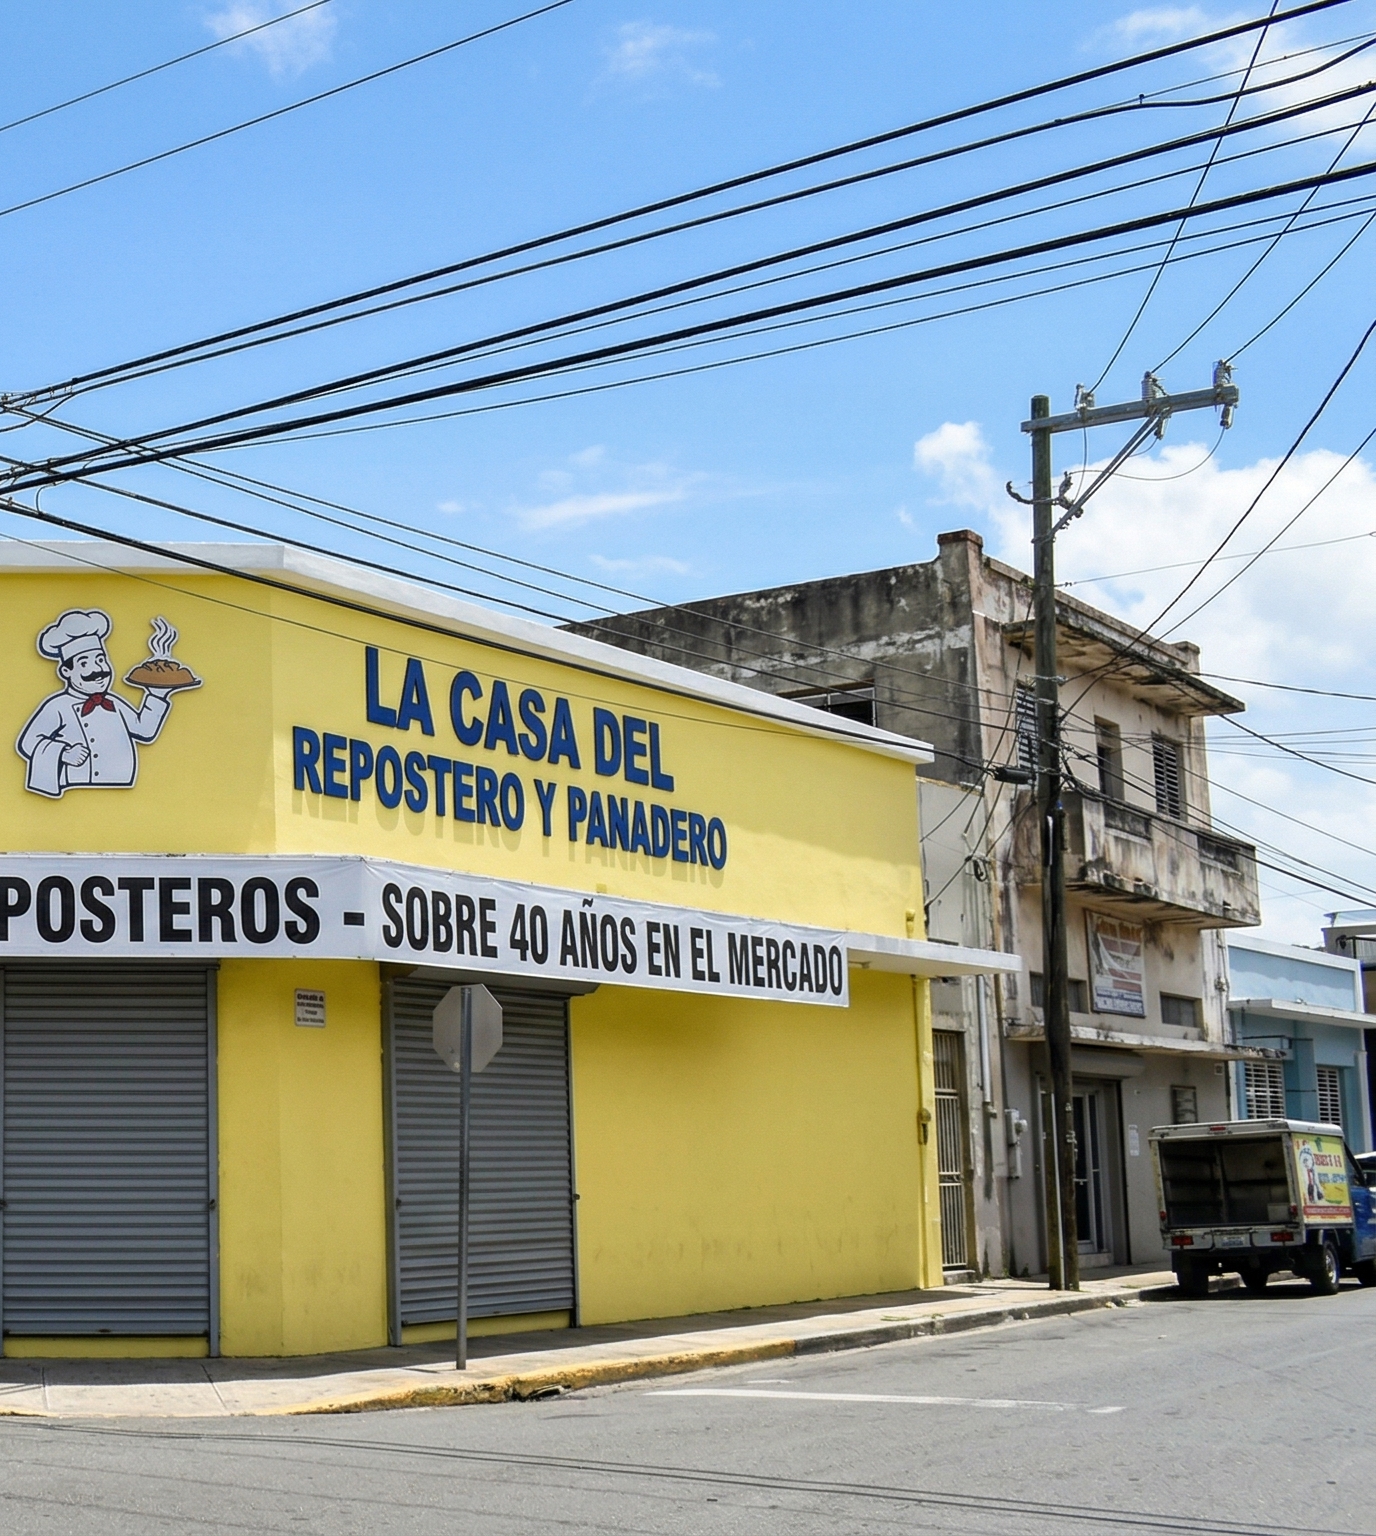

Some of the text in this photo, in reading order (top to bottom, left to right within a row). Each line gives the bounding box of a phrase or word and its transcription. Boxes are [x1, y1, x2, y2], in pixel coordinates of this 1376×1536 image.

[365, 646, 675, 792] LA CASA DEL
[292, 725, 727, 870] REPOSTERO Y PANADERO
[381, 882, 498, 959] SOBRE
[509, 903, 548, 965] 40
[559, 898, 637, 974] AÑOS
[647, 920, 681, 979] EN
[690, 925, 720, 983] EL
[728, 931, 843, 996] MERCADO
